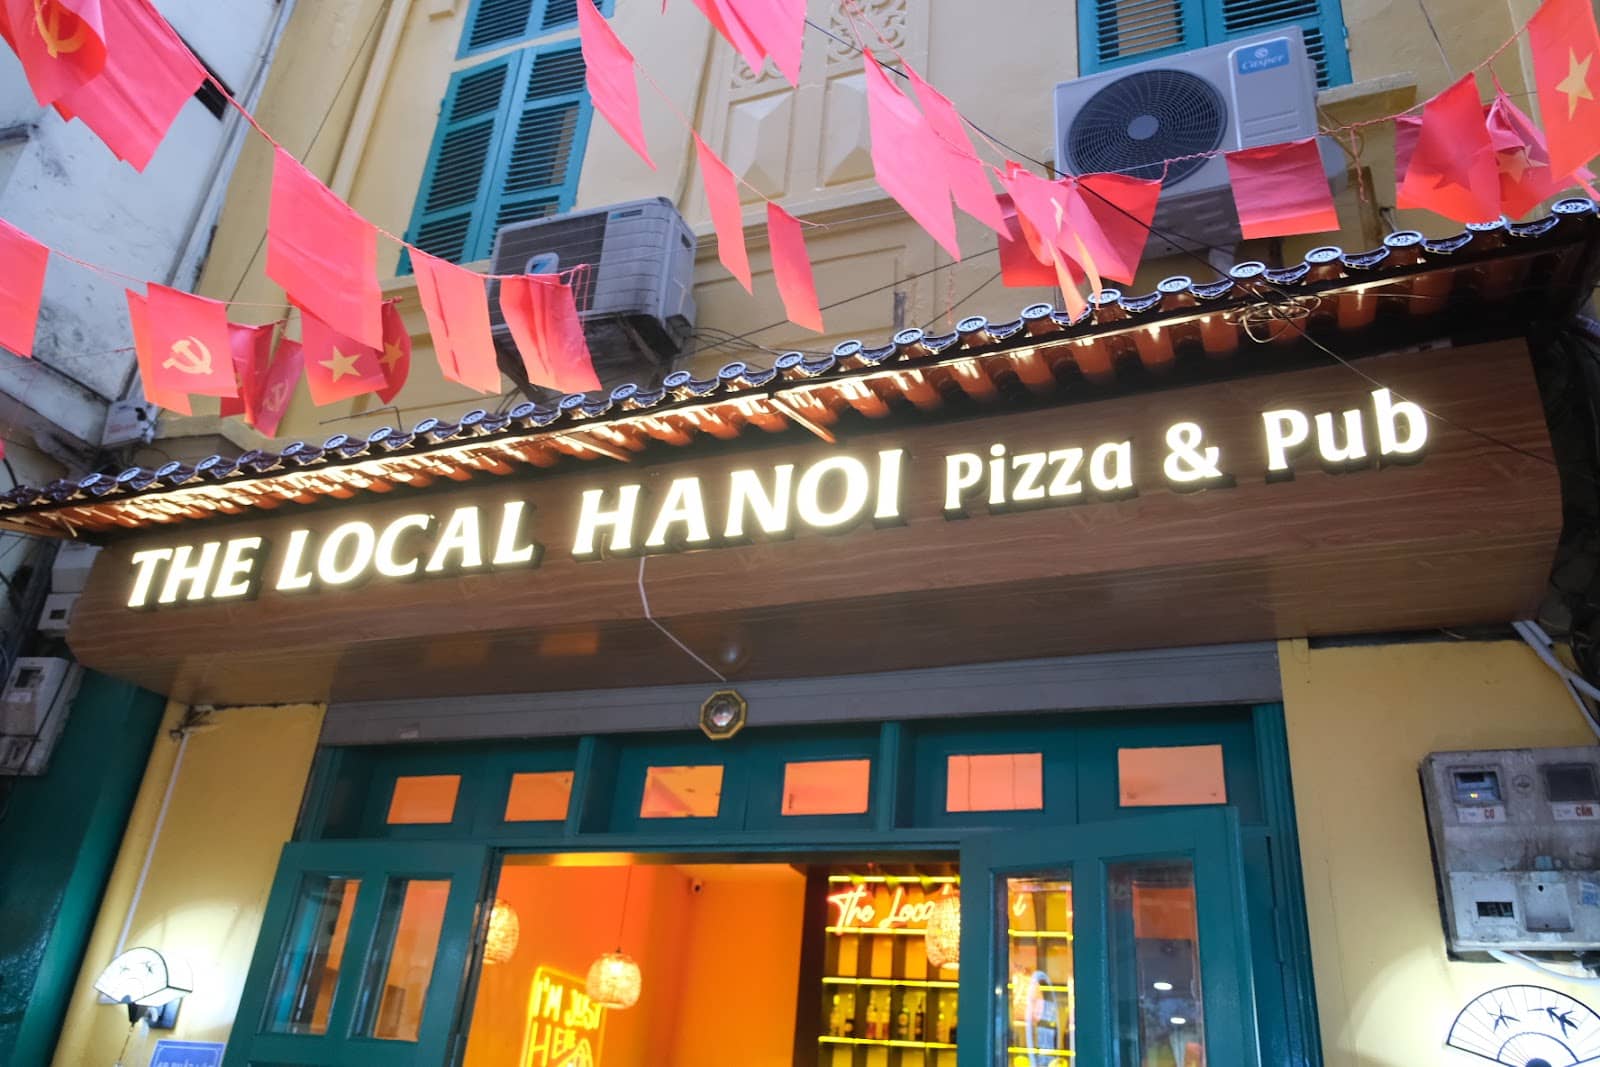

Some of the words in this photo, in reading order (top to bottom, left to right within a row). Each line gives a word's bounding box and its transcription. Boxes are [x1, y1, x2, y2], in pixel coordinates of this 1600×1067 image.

[127, 536, 262, 608] THE
[275, 501, 535, 592] LOCAL
[572, 449, 904, 555] HANOI
[944, 440, 1134, 511] Pizza
[1163, 422, 1224, 483] &
[1262, 388, 1429, 472] Pub
